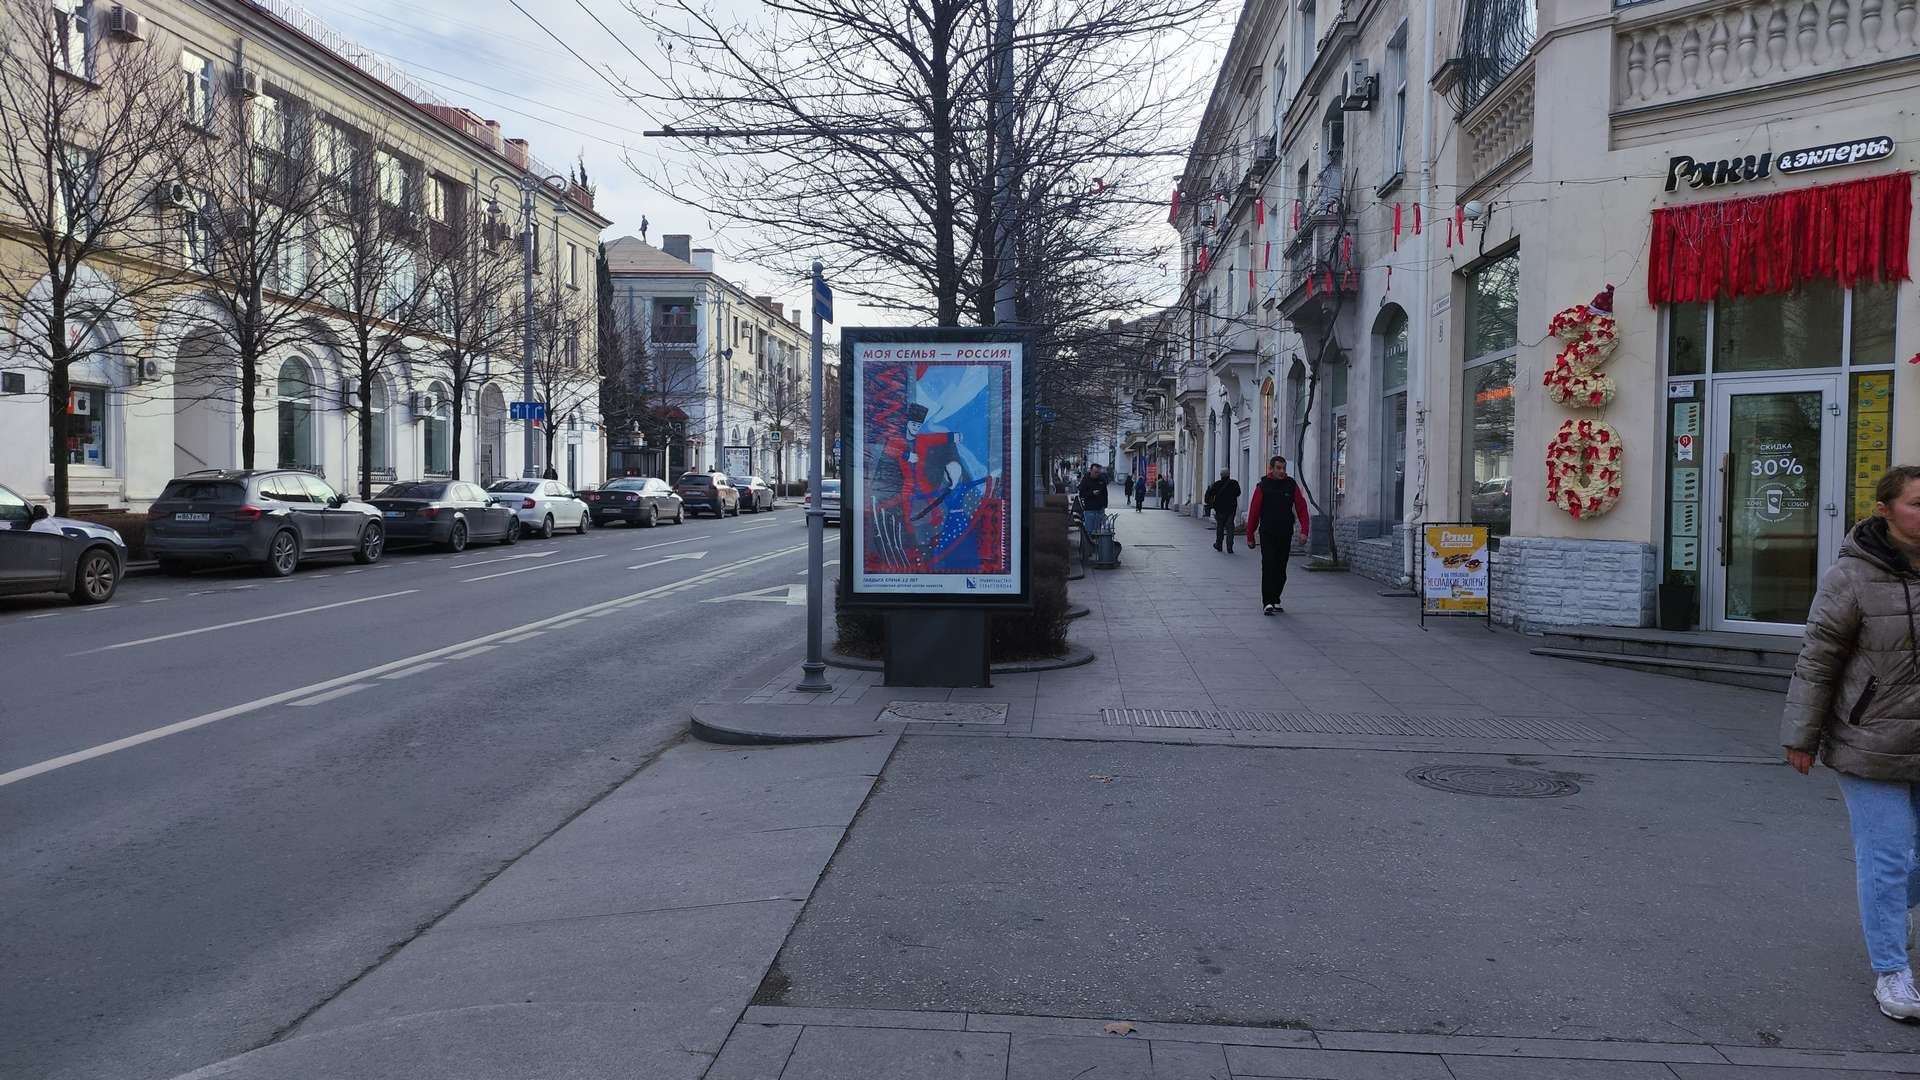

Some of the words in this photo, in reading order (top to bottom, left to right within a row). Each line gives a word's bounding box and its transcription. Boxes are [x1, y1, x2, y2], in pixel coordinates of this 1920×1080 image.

[1664, 152, 1773, 193] Раки
[863, 349, 891, 359] МОЯ
[896, 349, 936, 359] СЕМЬЯ
[956, 349, 1012, 359] РОССИЯ!
[1759, 443, 1793, 451] СКИДКА
[1751, 457, 1804, 476] 30%
